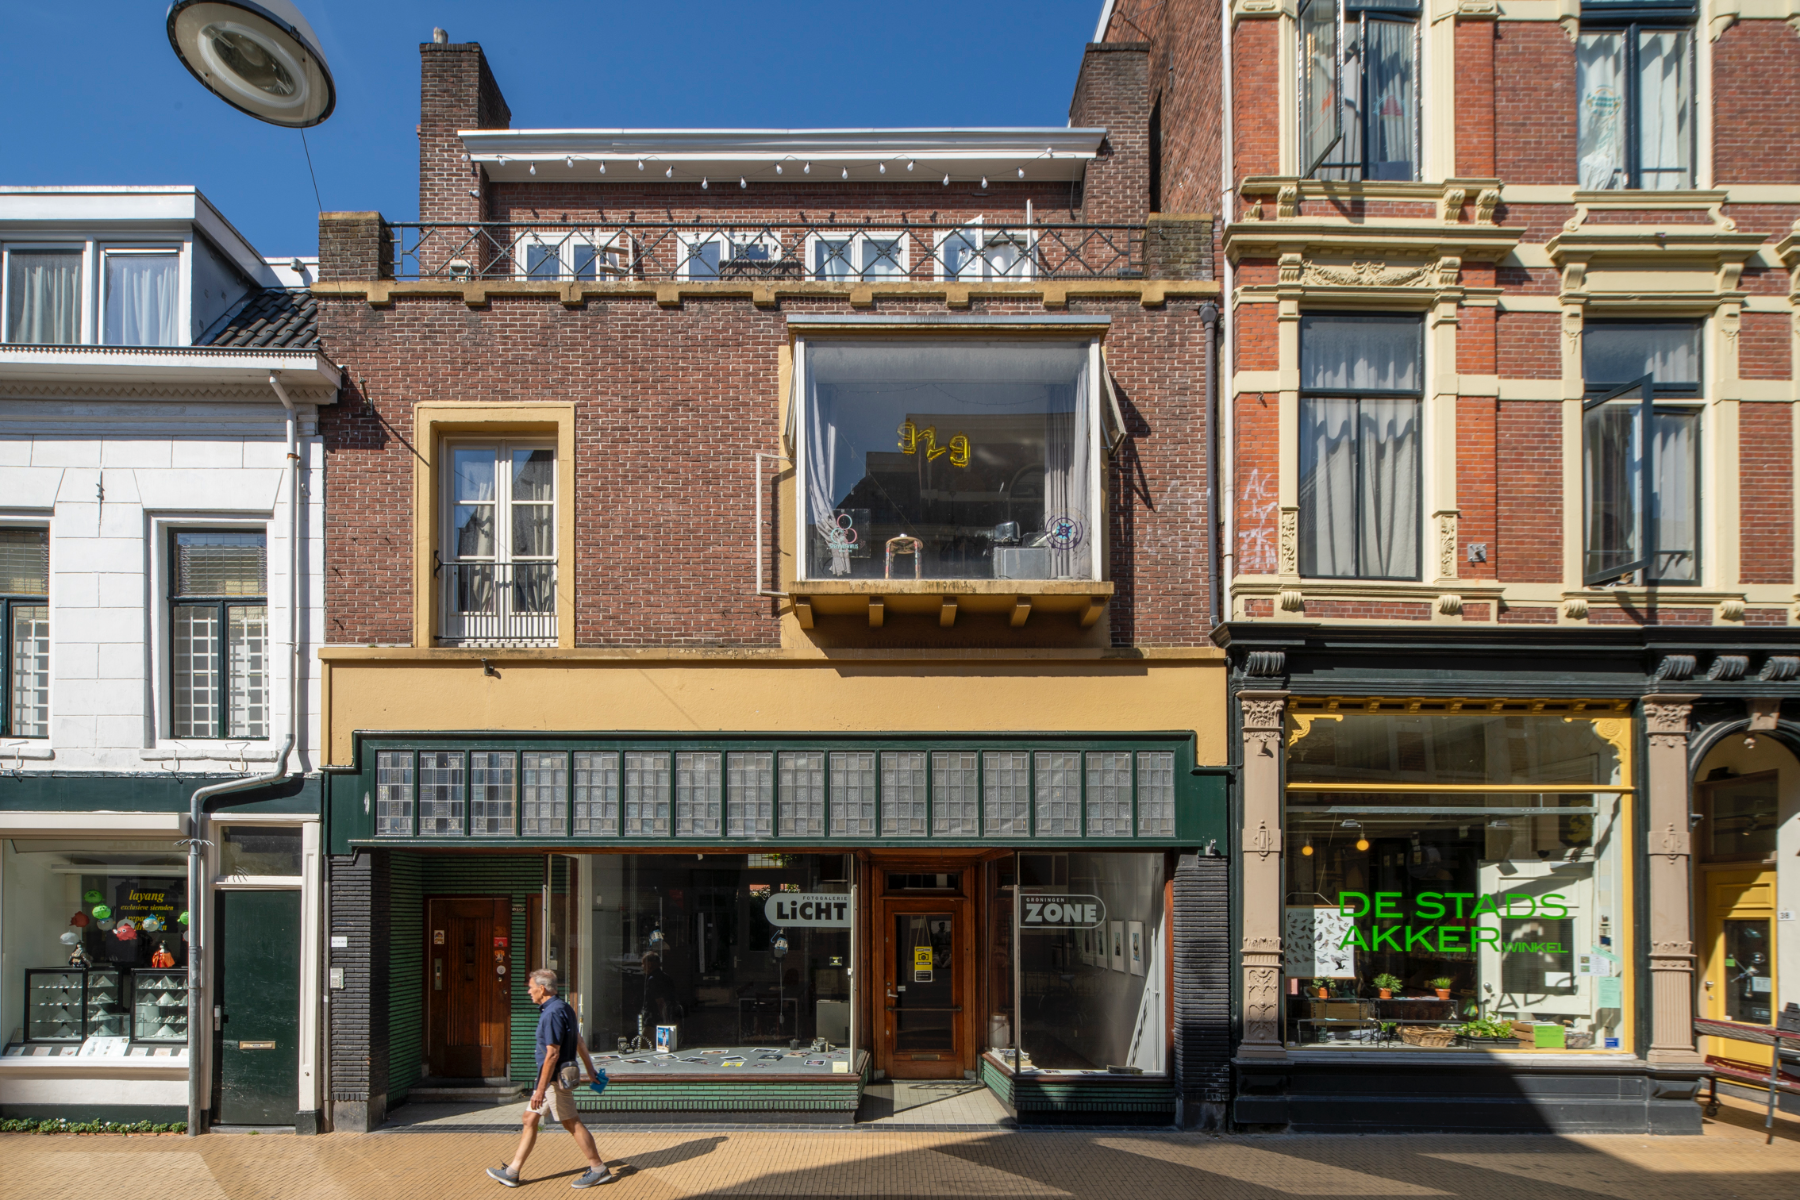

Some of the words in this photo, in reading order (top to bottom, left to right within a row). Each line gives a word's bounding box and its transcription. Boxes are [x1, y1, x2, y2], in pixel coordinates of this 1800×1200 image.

[128, 889, 165, 903] layang
[1339, 891, 1404, 919] DE
[1415, 891, 1569, 920] STADS
[120, 903, 149, 911] exclusieve
[149, 903, 174, 911] sieraden
[776, 900, 847, 921] LiCHT
[1024, 902, 1097, 923] ZONE
[1338, 925, 1501, 953] AKKER
[1130, 998, 1148, 1067] ONE
